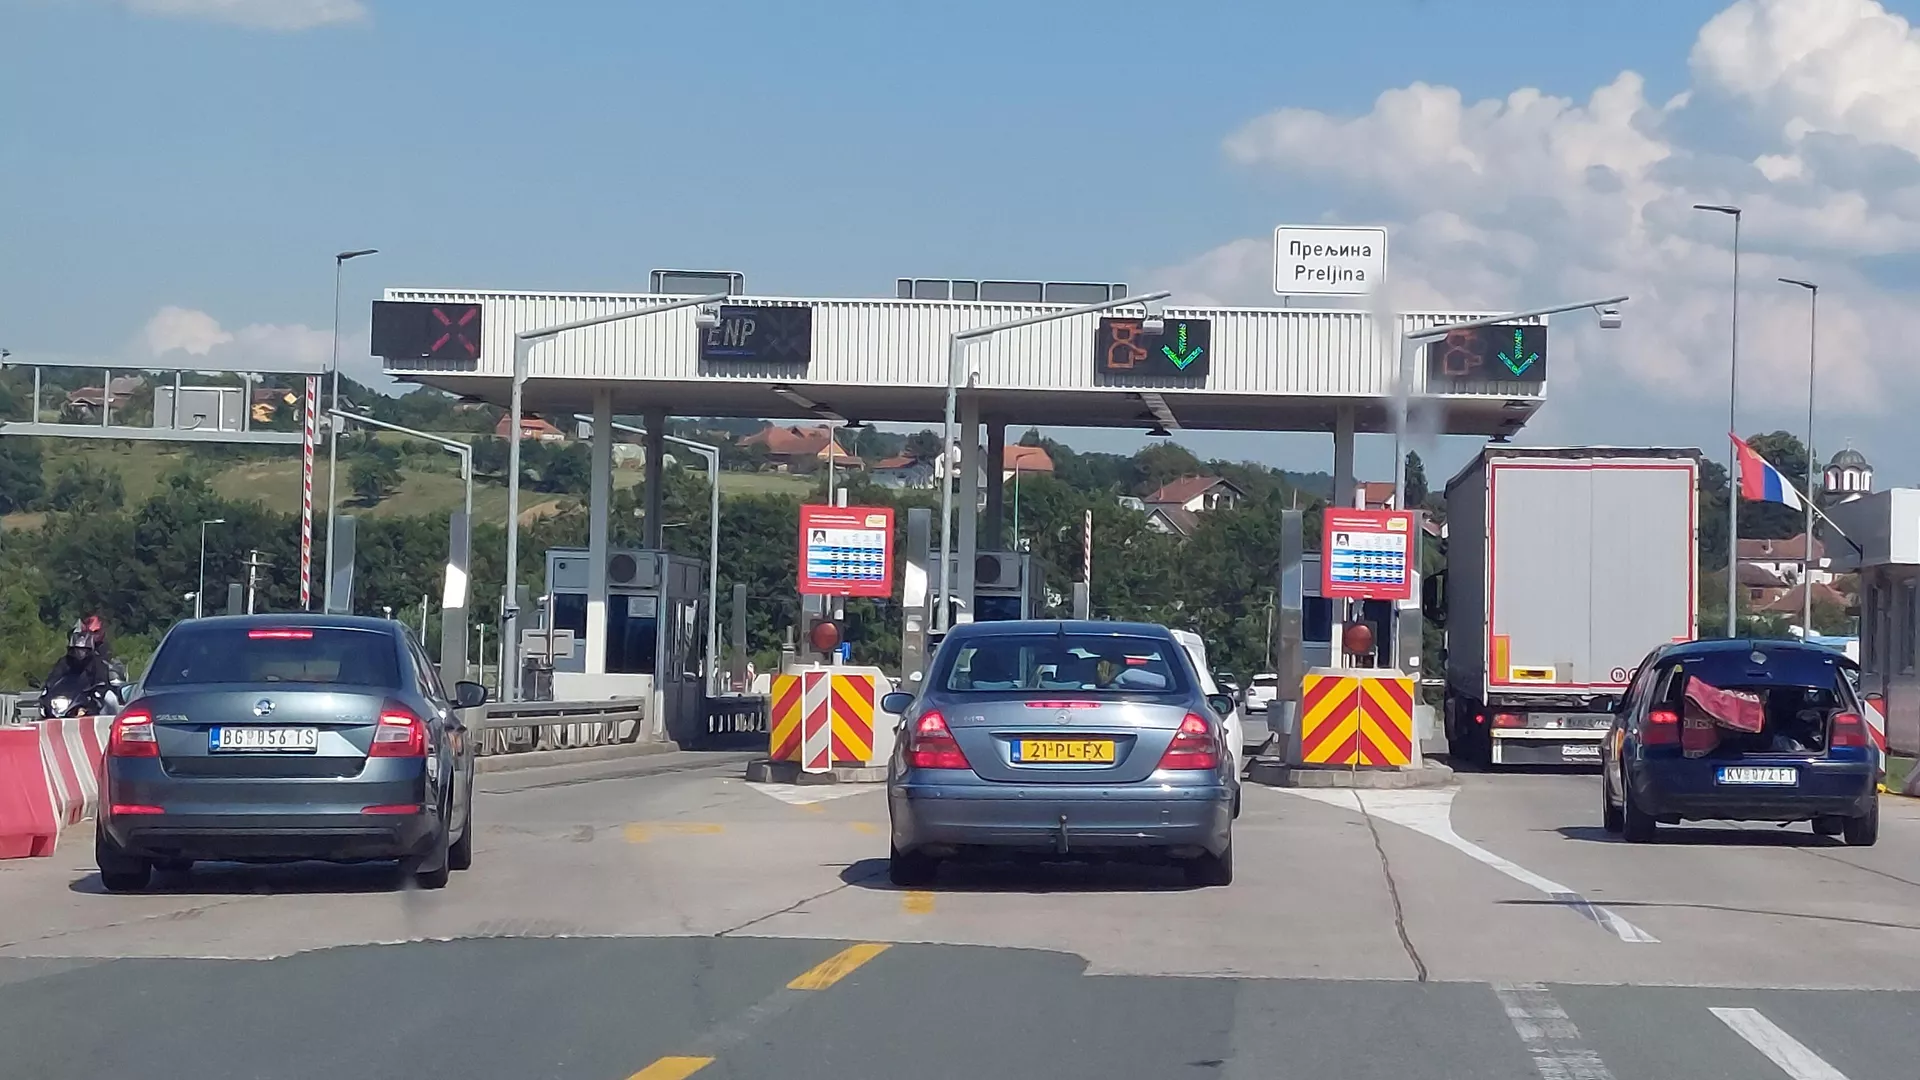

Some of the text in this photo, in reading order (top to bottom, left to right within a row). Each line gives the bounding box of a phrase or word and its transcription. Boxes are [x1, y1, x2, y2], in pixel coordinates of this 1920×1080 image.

[1290, 240, 1371, 260] Прељина
[1295, 264, 1365, 285] Preljina
[707, 318, 756, 346] ENP
